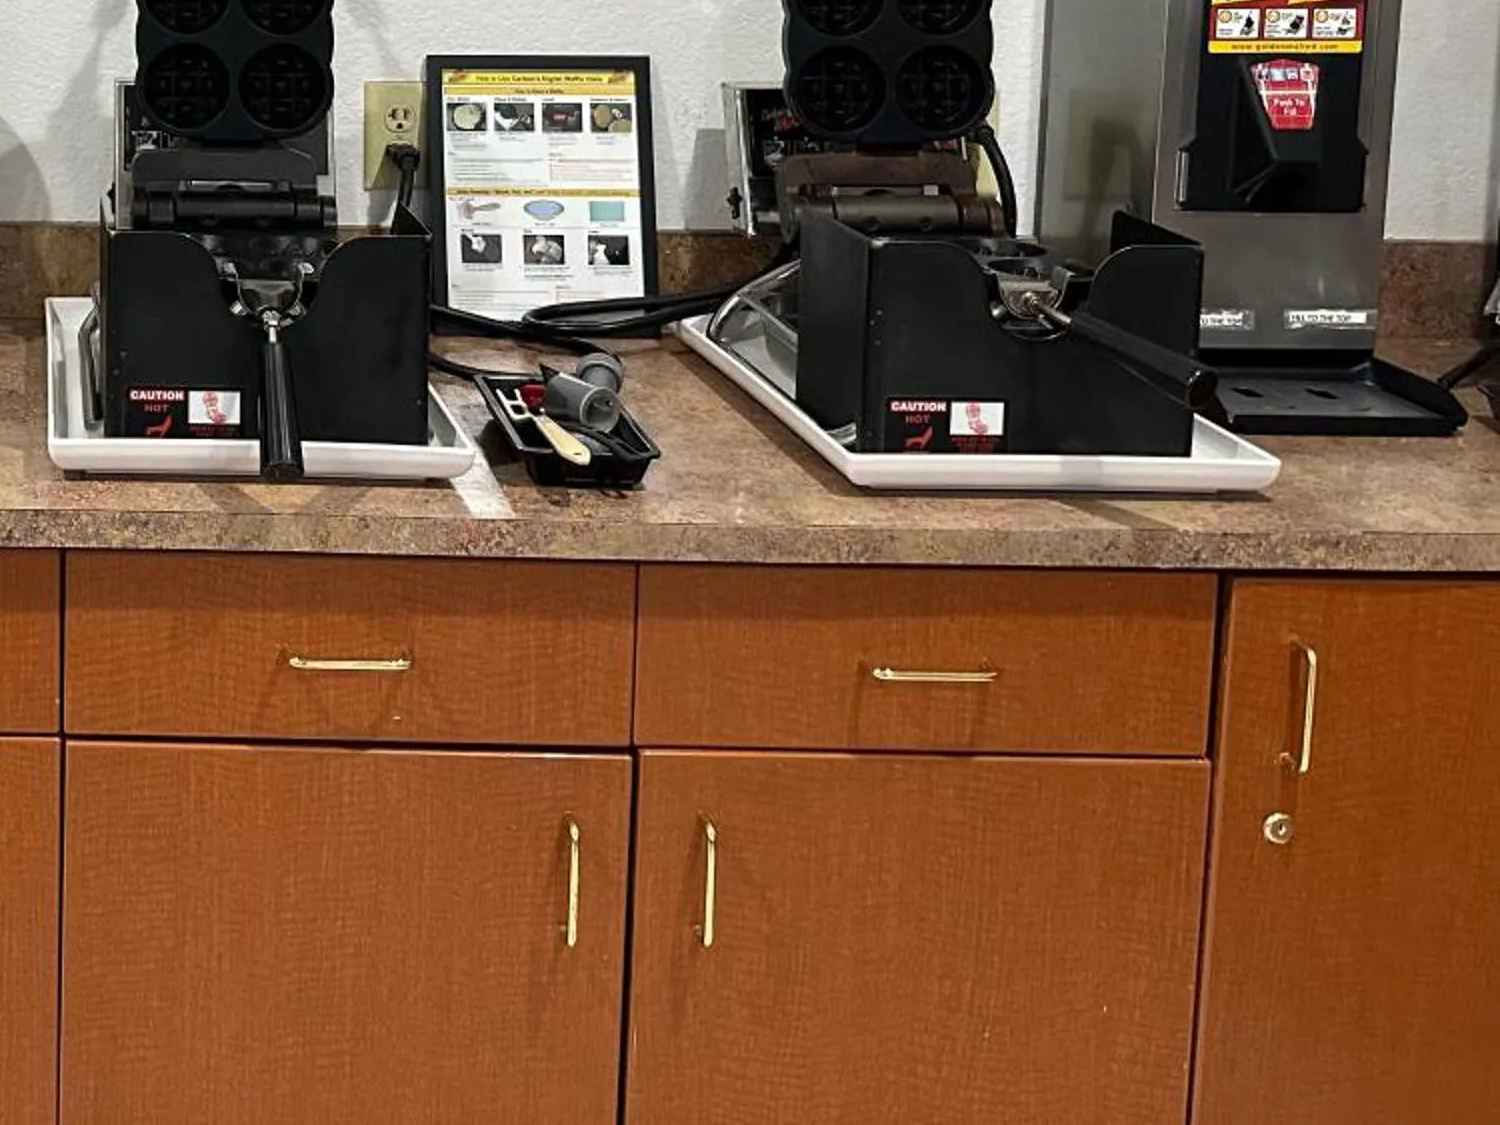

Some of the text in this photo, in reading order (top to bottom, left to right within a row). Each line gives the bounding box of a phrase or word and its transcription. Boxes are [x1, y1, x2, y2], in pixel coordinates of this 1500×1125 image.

[130, 390, 185, 401] CAUTION
[144, 404, 169, 413] HOT
[890, 401, 947, 412] CAUTION
[905, 415, 931, 424] HOT
